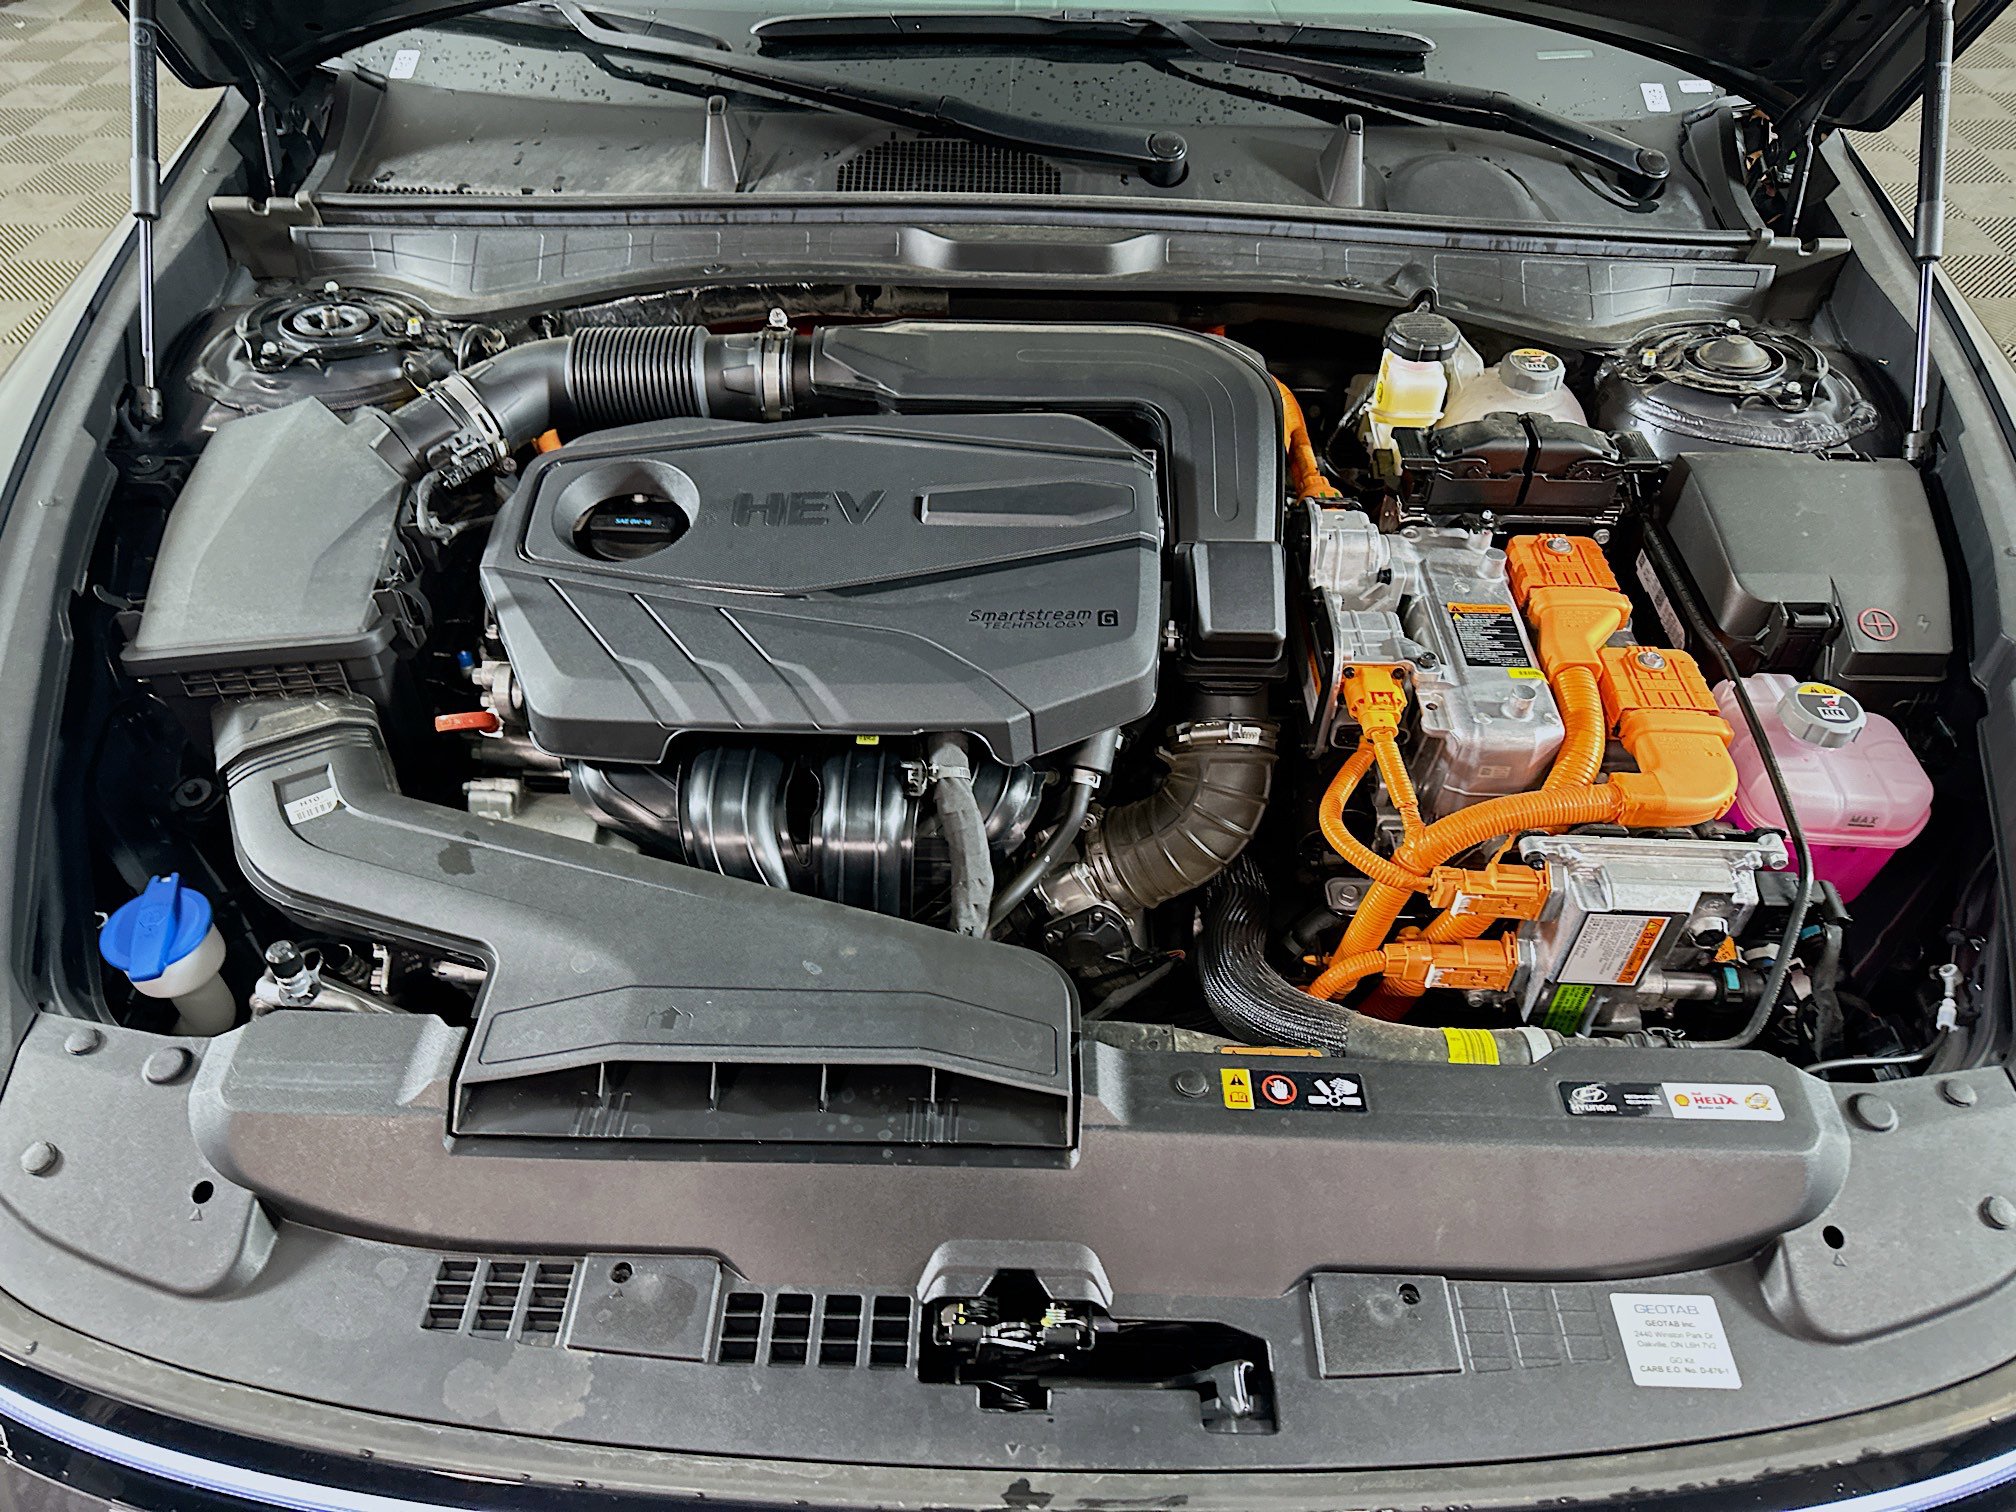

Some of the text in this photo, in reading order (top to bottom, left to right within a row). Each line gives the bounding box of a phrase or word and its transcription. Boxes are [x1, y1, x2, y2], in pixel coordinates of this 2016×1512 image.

[732, 490, 887, 527] HEV
[968, 609, 1092, 622] Smartstream
[984, 621, 1088, 629] TECHNOLOGY
[1850, 816, 1879, 824] MAX
[1693, 1096, 1739, 1105] HELIX
[1634, 1304, 1699, 1314] GEOTAB
